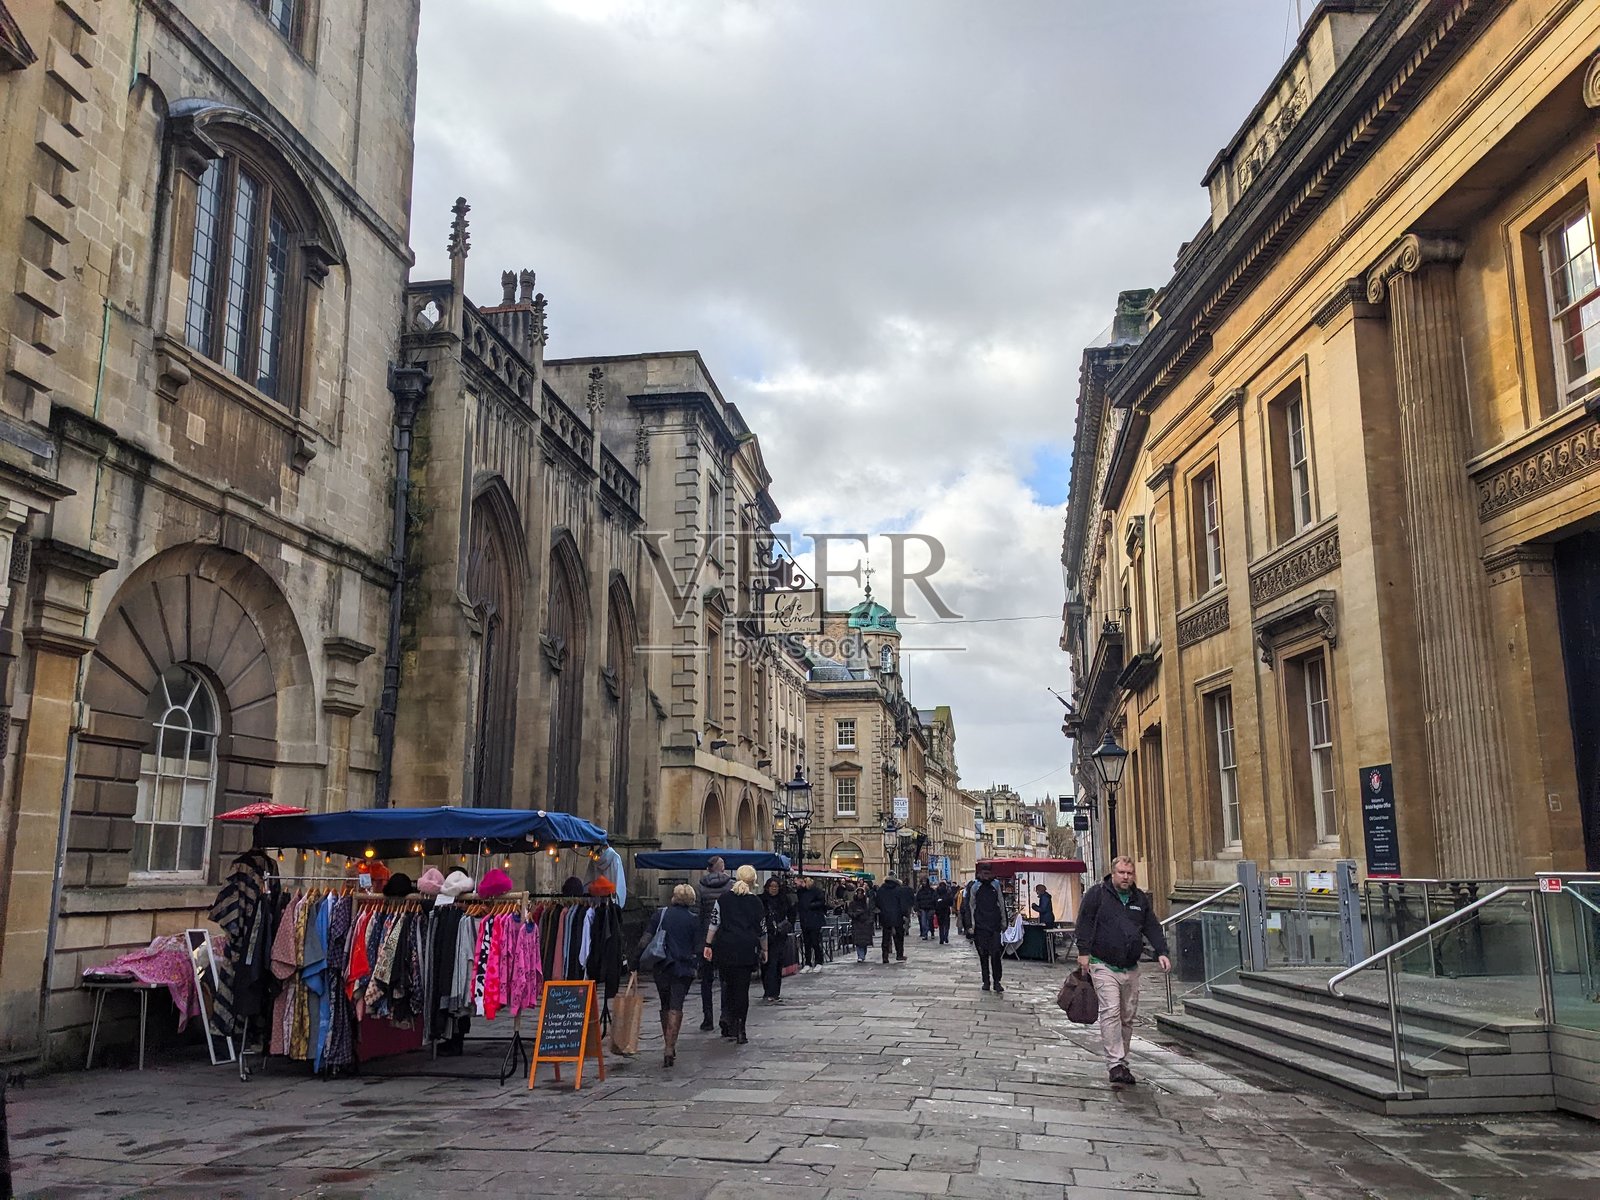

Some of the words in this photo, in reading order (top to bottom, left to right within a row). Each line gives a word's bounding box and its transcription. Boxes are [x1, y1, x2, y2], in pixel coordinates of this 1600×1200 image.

[775, 594, 802, 615] Cafe
[769, 611, 815, 627] Revival
[550, 987, 571, 998] Quality
[549, 1012, 565, 1020] Vintage
